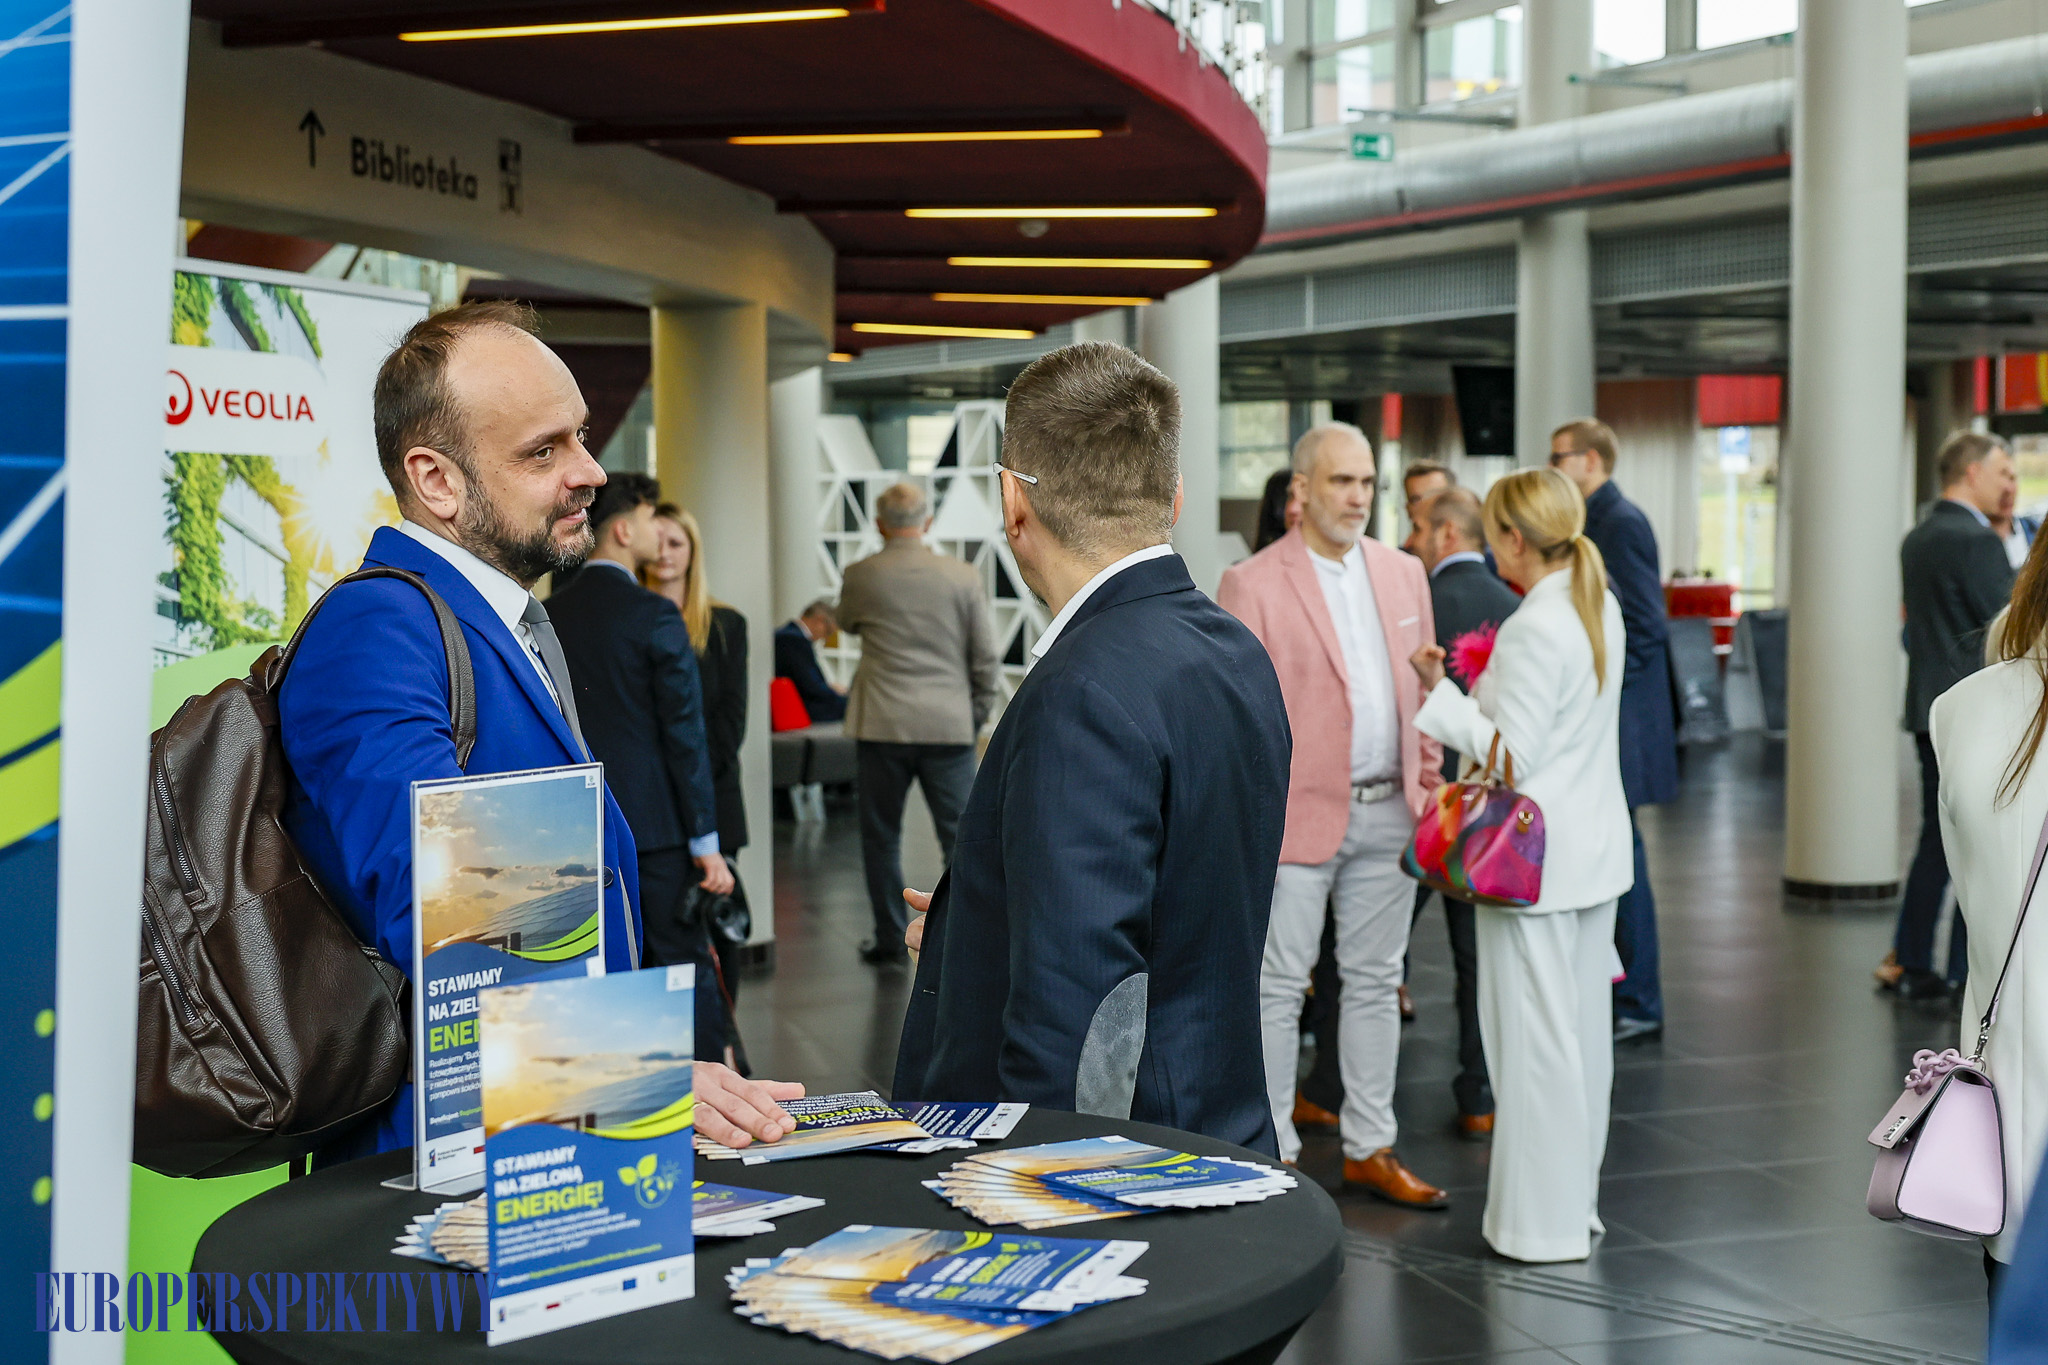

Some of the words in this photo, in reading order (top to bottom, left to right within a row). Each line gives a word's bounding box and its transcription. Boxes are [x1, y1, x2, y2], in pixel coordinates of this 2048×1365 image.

[352, 136, 478, 200] Biblioteka
[200, 388, 315, 422] VEOLIA
[428, 967, 503, 997] STAWIAMY
[429, 1002, 449, 1022] NA
[450, 996, 480, 1017] ZIEL
[493, 1145, 577, 1177] STAWIAMY
[494, 1178, 518, 1198] NA
[496, 1180, 604, 1225] ENERGIĘ!
